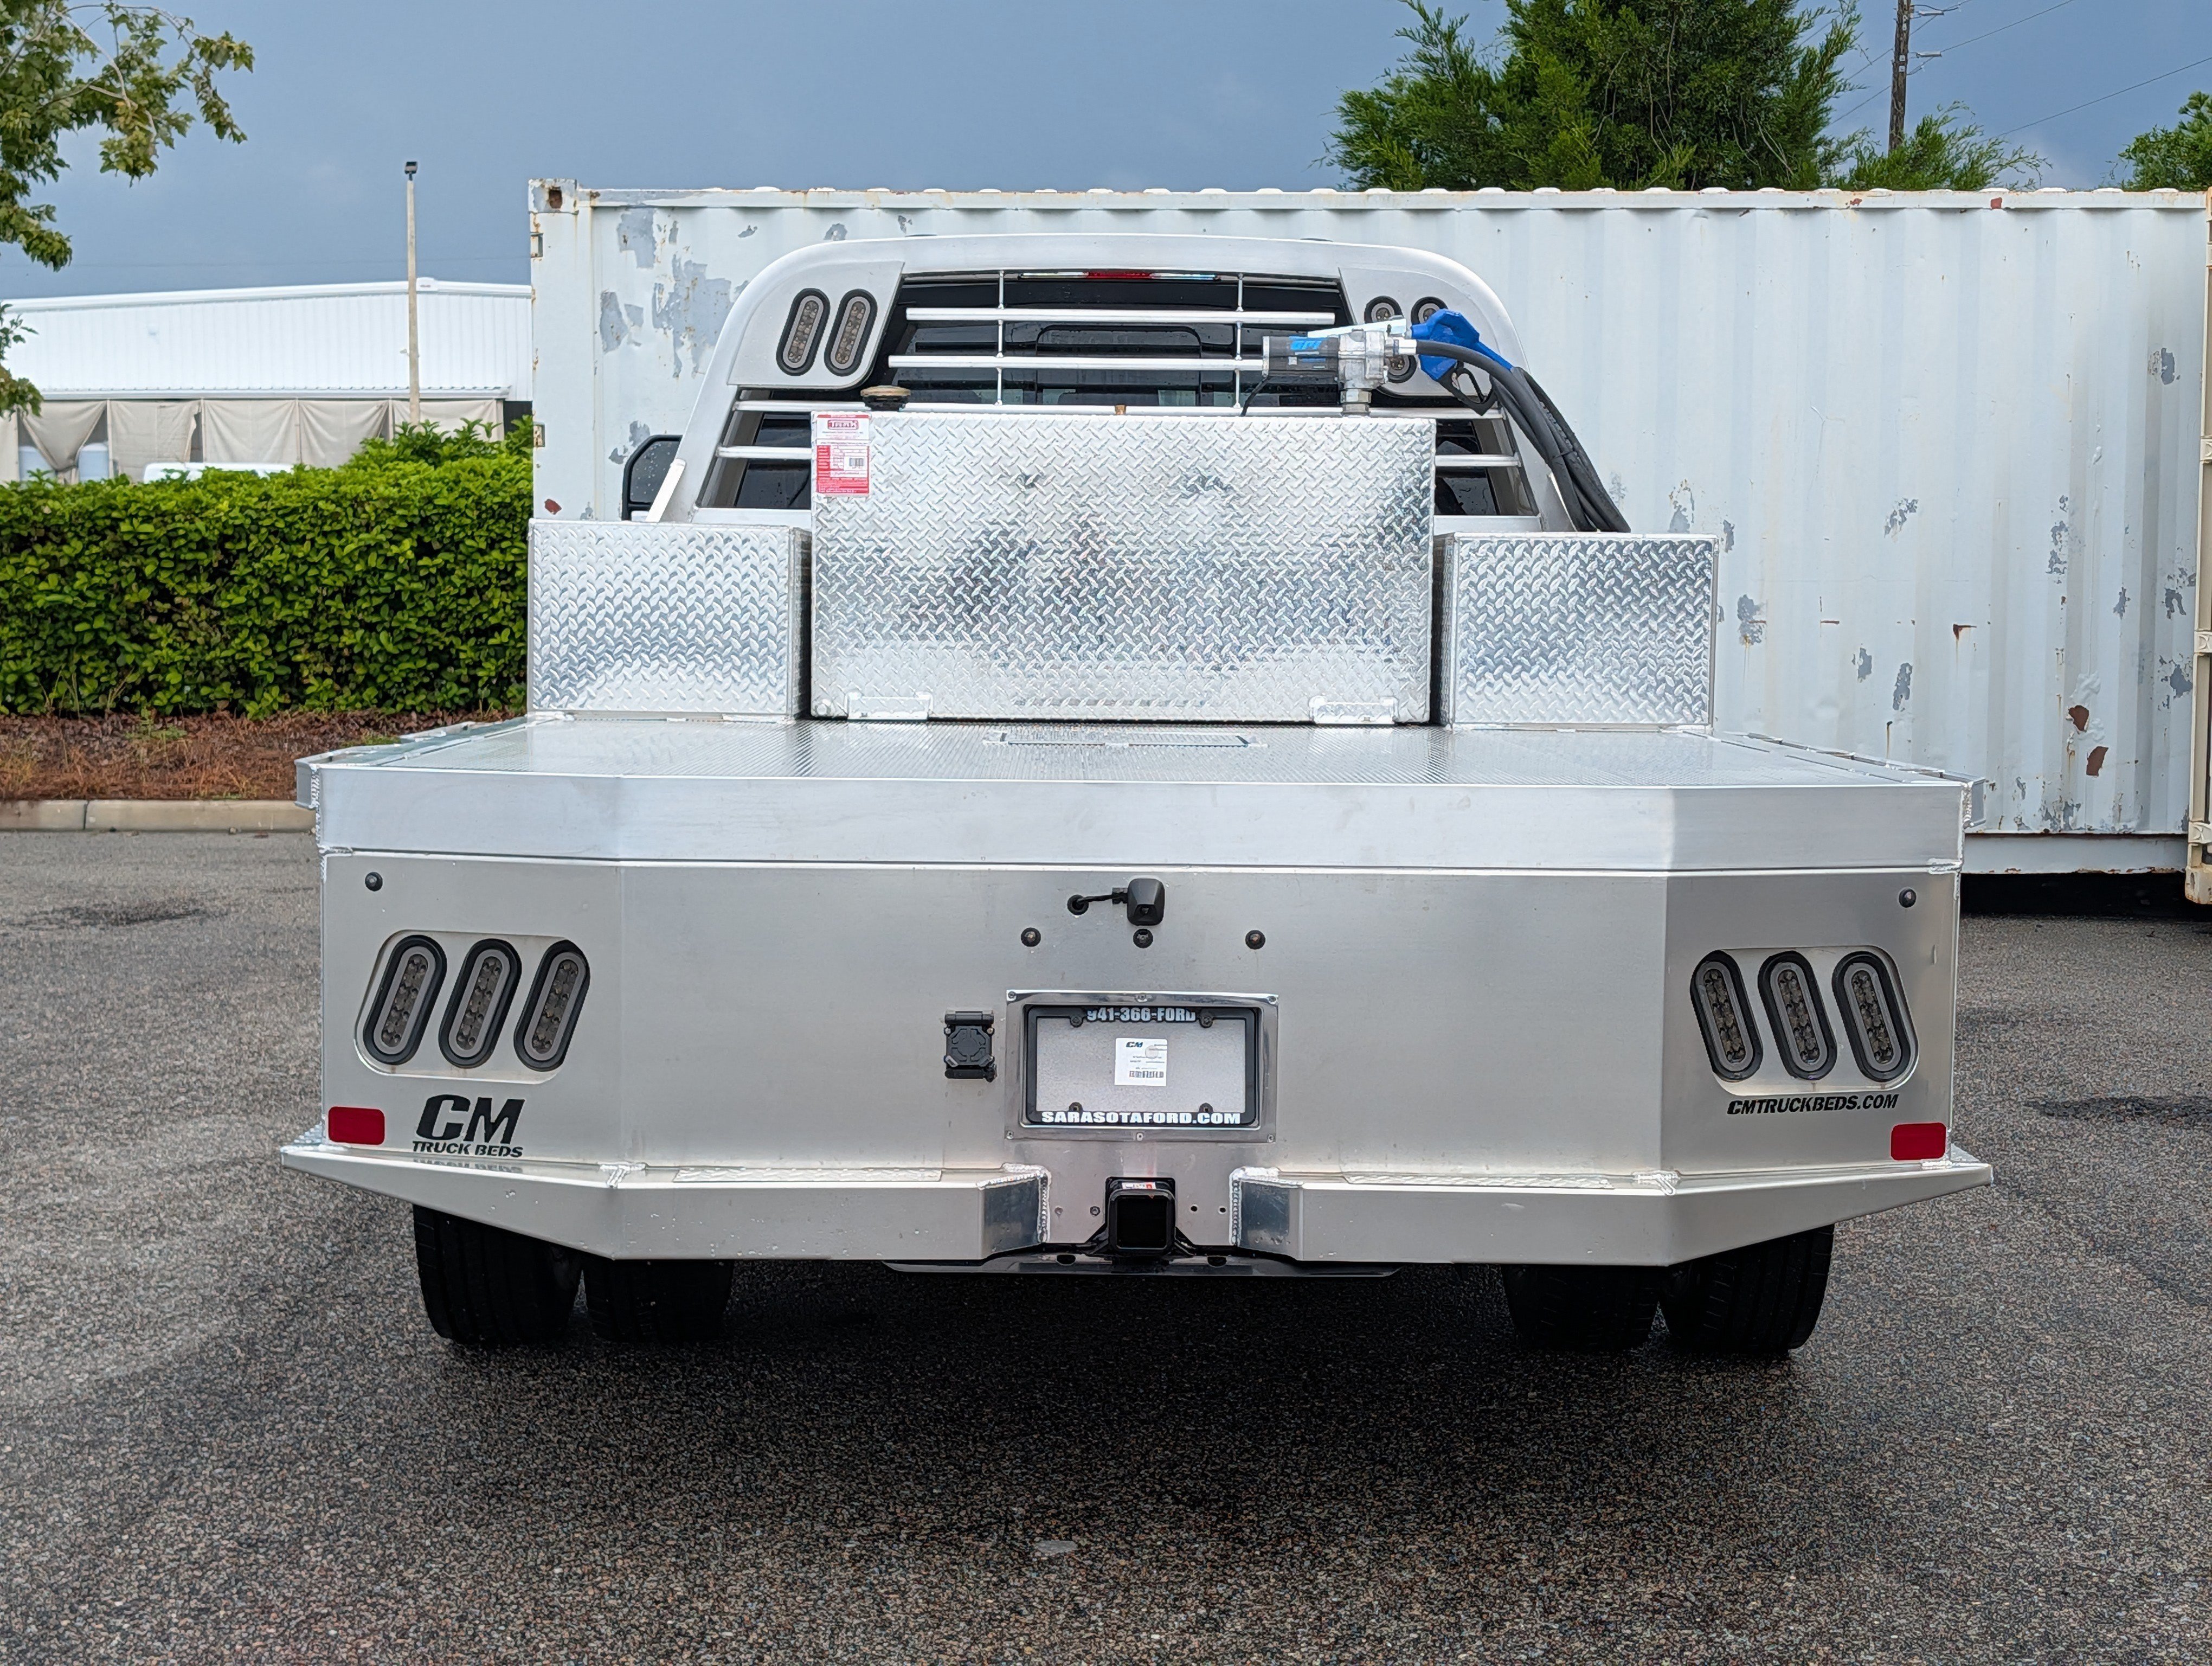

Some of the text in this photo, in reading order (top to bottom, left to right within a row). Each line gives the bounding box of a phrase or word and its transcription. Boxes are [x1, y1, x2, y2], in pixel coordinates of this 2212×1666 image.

[1087, 1007, 1196, 1021] 941-366-FORD
[1727, 1094, 1899, 1115] CMTRUCKBEDS.COM
[416, 1094, 525, 1145] CM
[1041, 1111, 1241, 1124] SARASOTAFORD.COM
[412, 1140, 524, 1158] TRUCK BEDS
